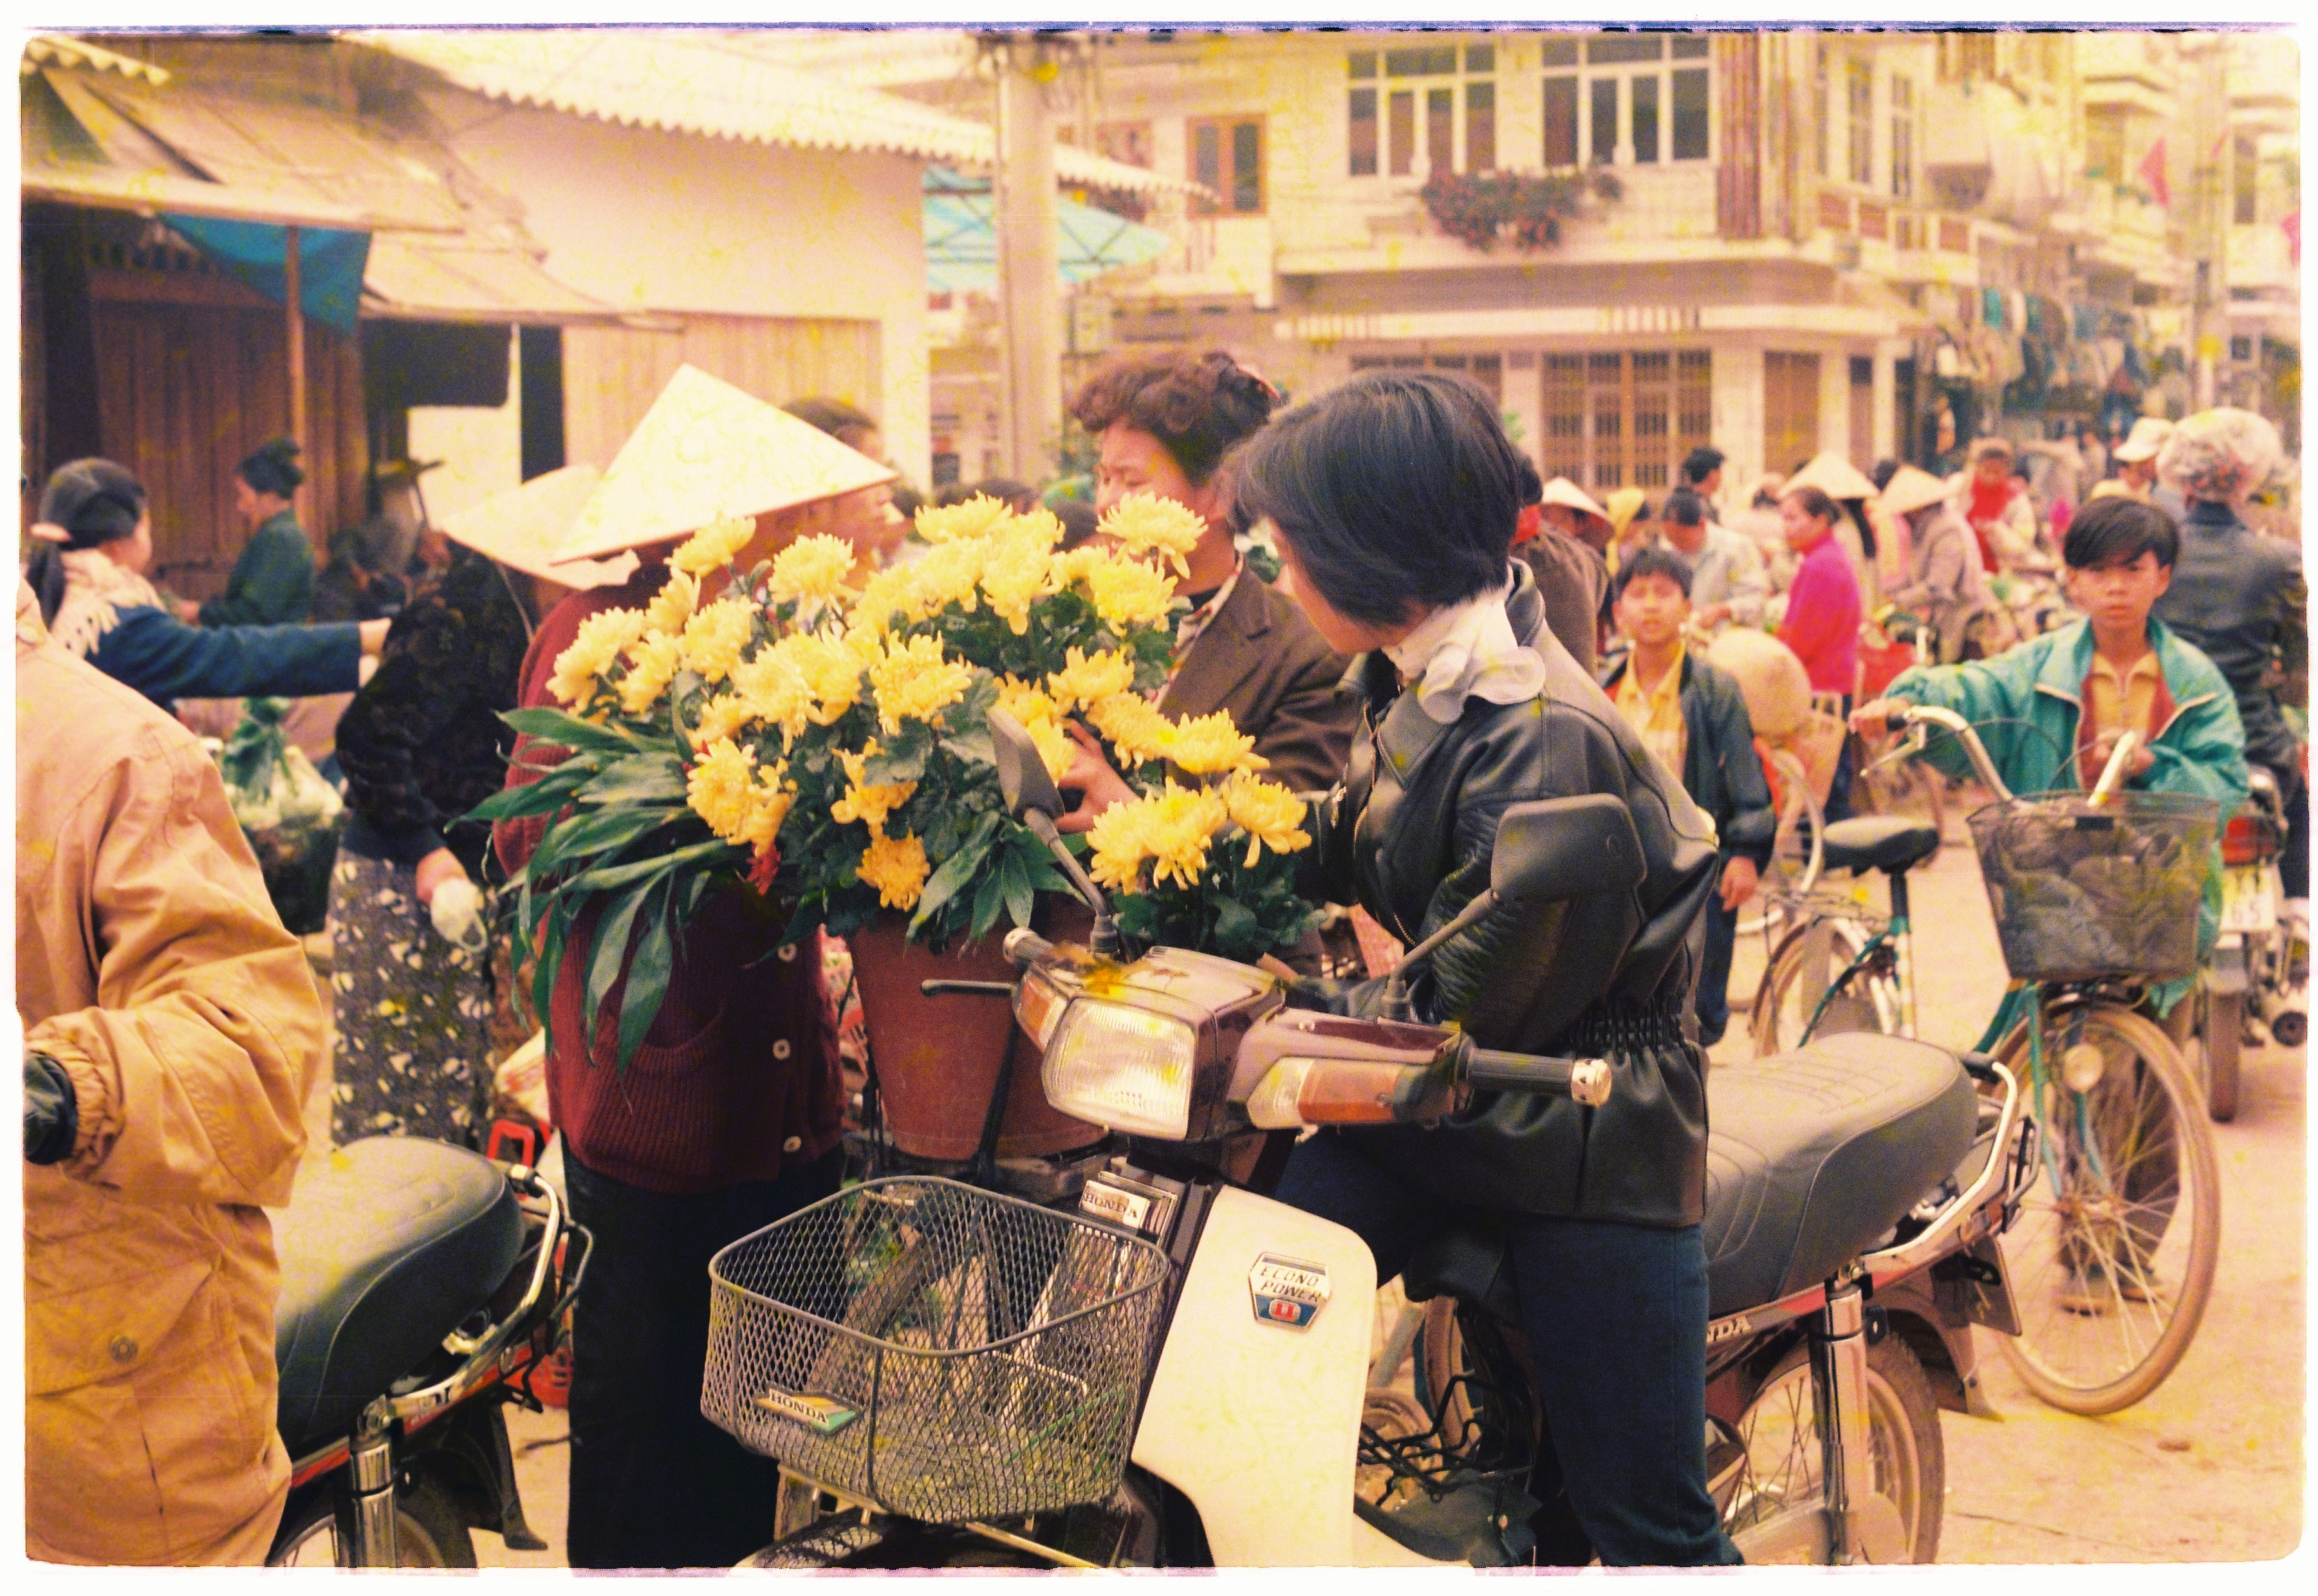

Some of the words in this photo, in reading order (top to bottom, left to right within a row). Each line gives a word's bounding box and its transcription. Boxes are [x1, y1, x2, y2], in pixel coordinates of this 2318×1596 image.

[1261, 1281, 1321, 1302] POWER
[1707, 1316, 1752, 1342] NDA
[770, 1391, 828, 1424] HONDA
